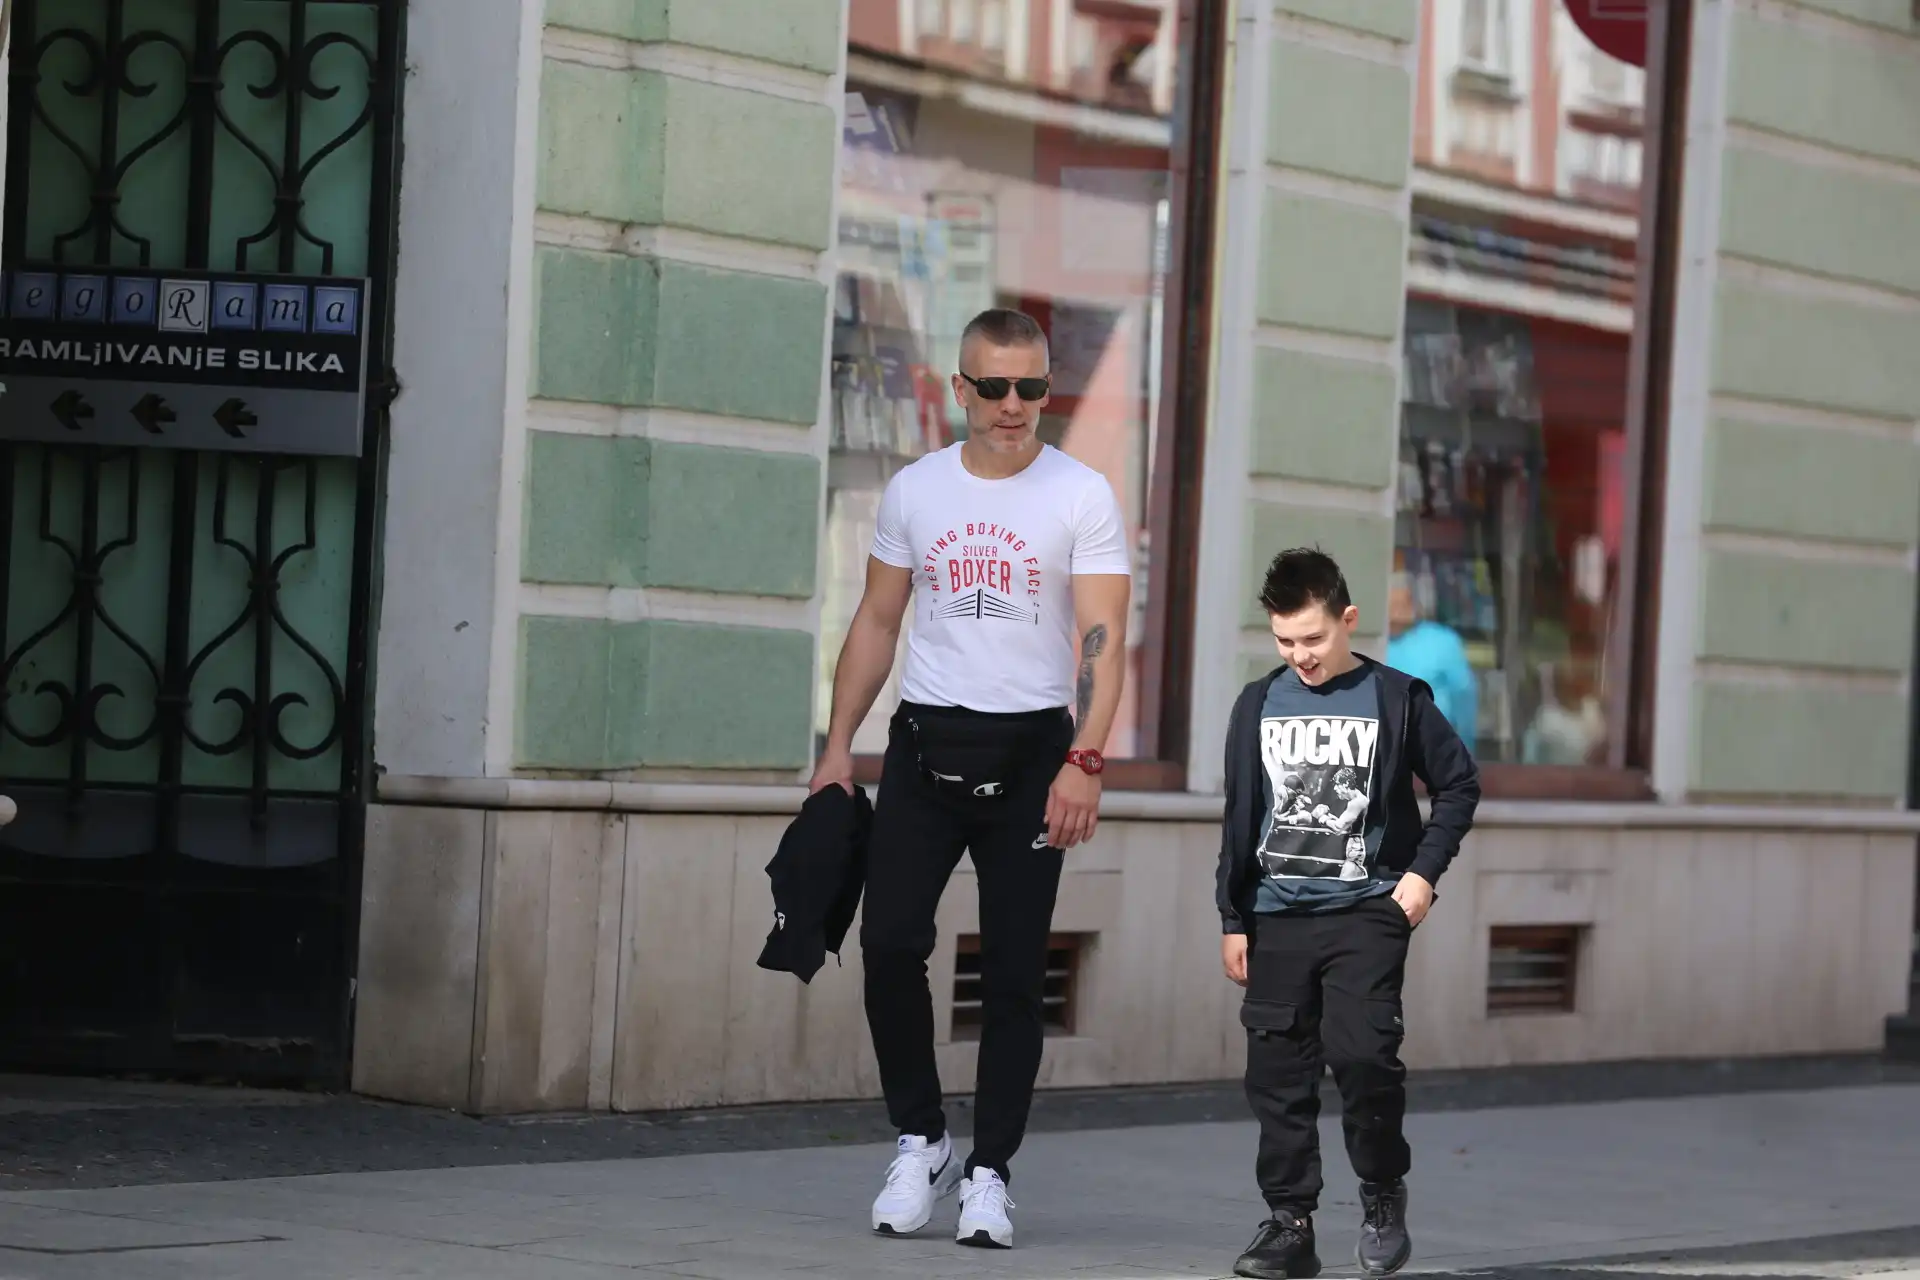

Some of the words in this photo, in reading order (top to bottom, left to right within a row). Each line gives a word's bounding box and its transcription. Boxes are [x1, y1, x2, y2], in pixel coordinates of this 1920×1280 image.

[238, 349, 345, 374] SLIKA
[924, 530, 958, 592] RESTING
[966, 522, 1026, 552] BOXING
[1023, 556, 1041, 597] FACE
[962, 545, 998, 557] SILVER
[948, 558, 1011, 595] BOXER
[1261, 719, 1376, 767] ROCKY
